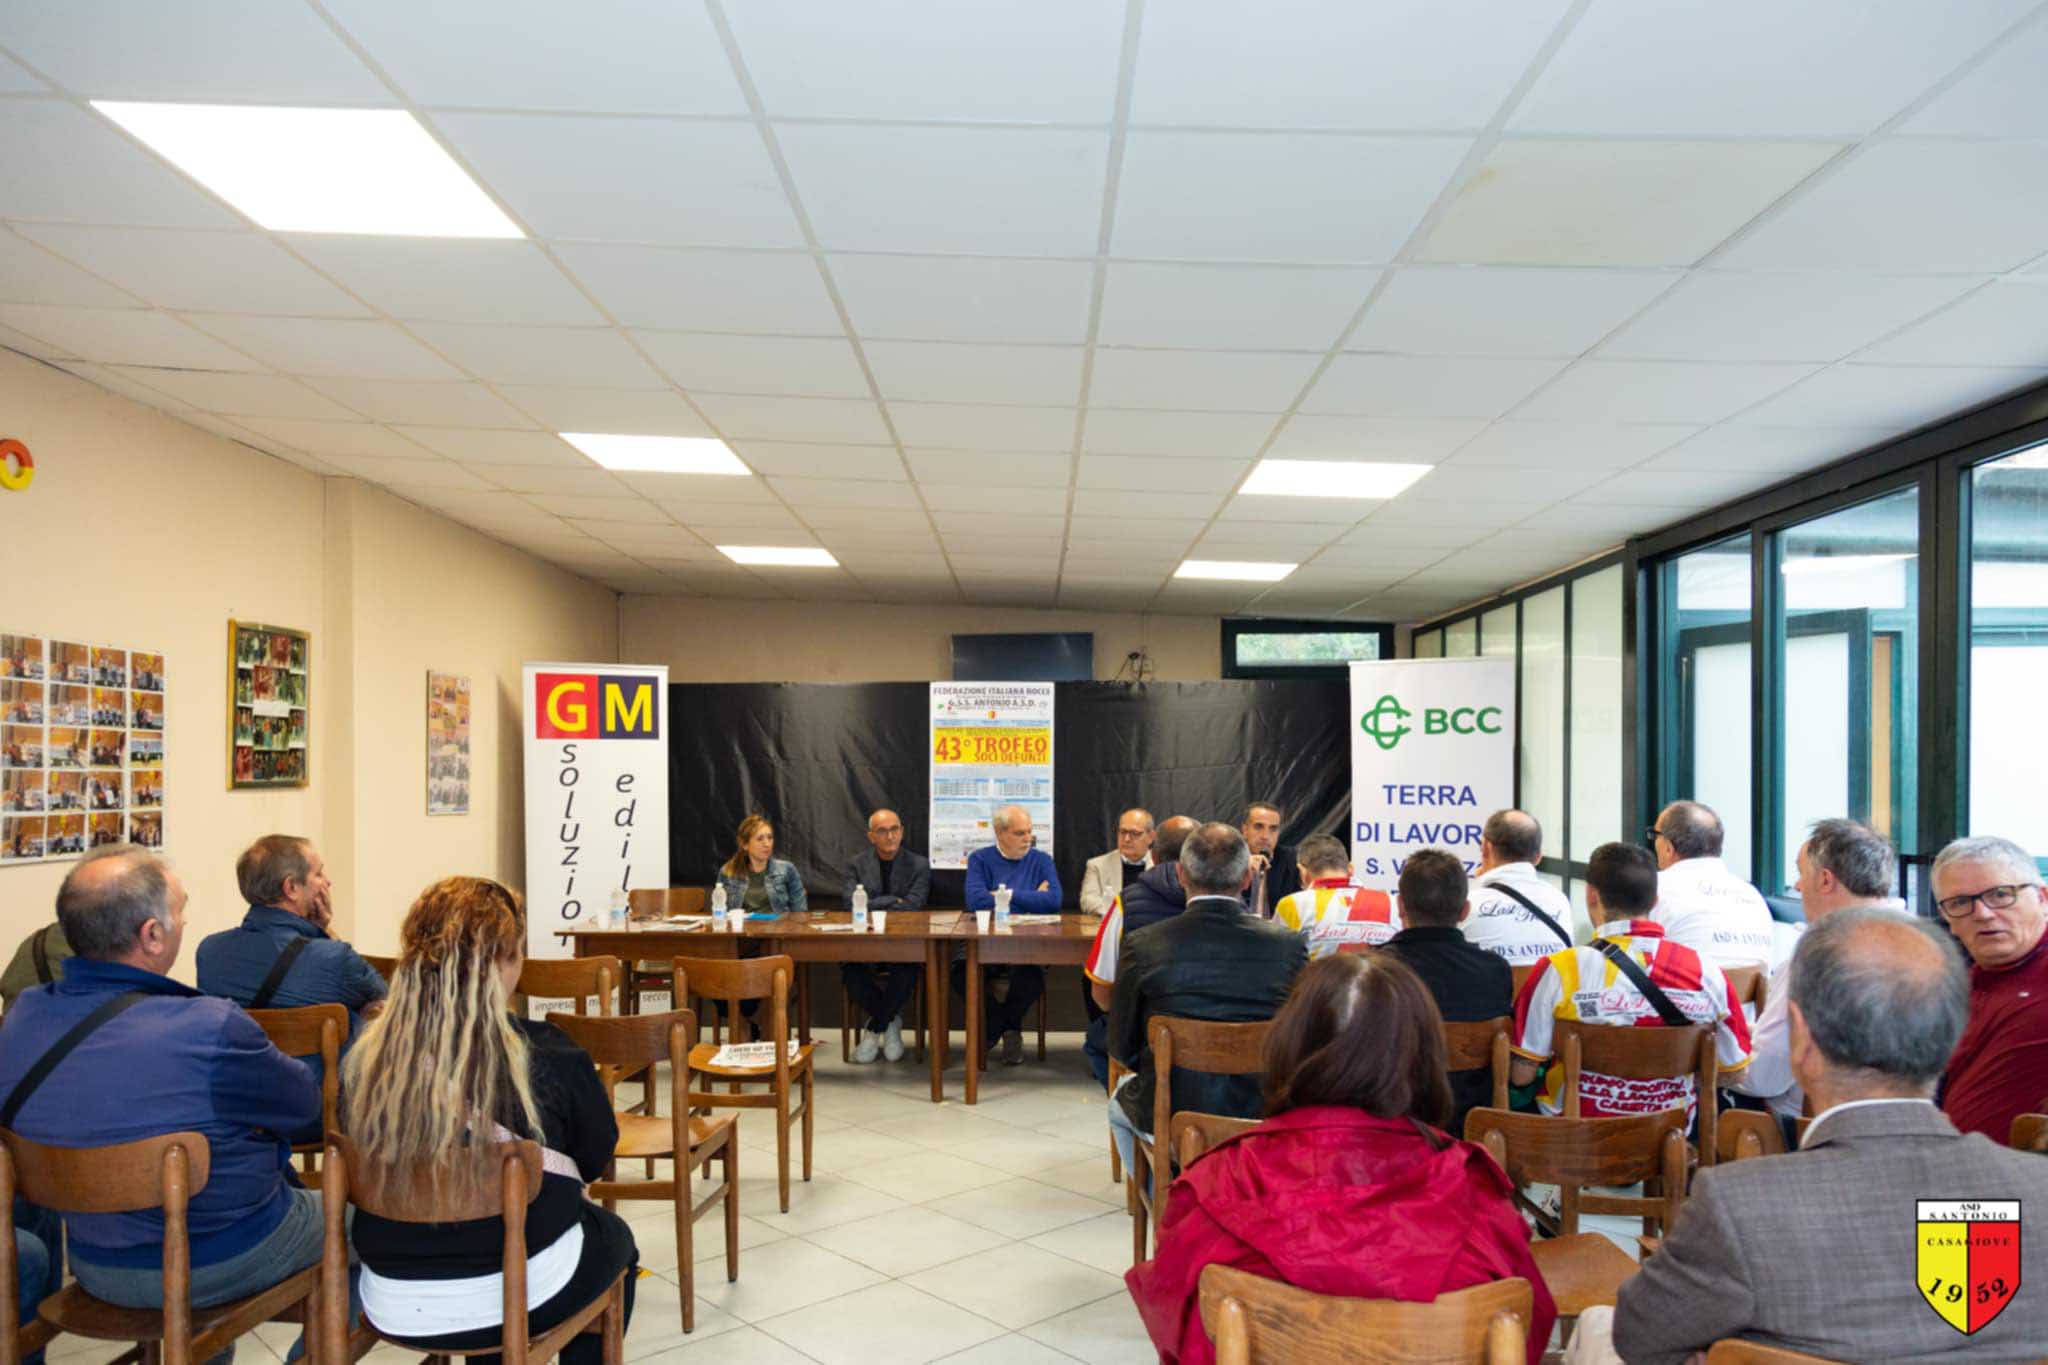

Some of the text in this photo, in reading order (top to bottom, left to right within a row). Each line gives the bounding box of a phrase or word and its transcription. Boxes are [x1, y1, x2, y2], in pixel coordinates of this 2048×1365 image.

[989, 687, 1024, 695] ITALIANA
[546, 681, 652, 732] GM
[1424, 707, 1503, 735] BCC
[974, 735, 1047, 753] TROFEO
[1383, 785, 1477, 806] TERRA
[615, 773, 636, 913] edil
[1357, 823, 1482, 845] DI LAVOR
[1366, 858, 1385, 875] S.
